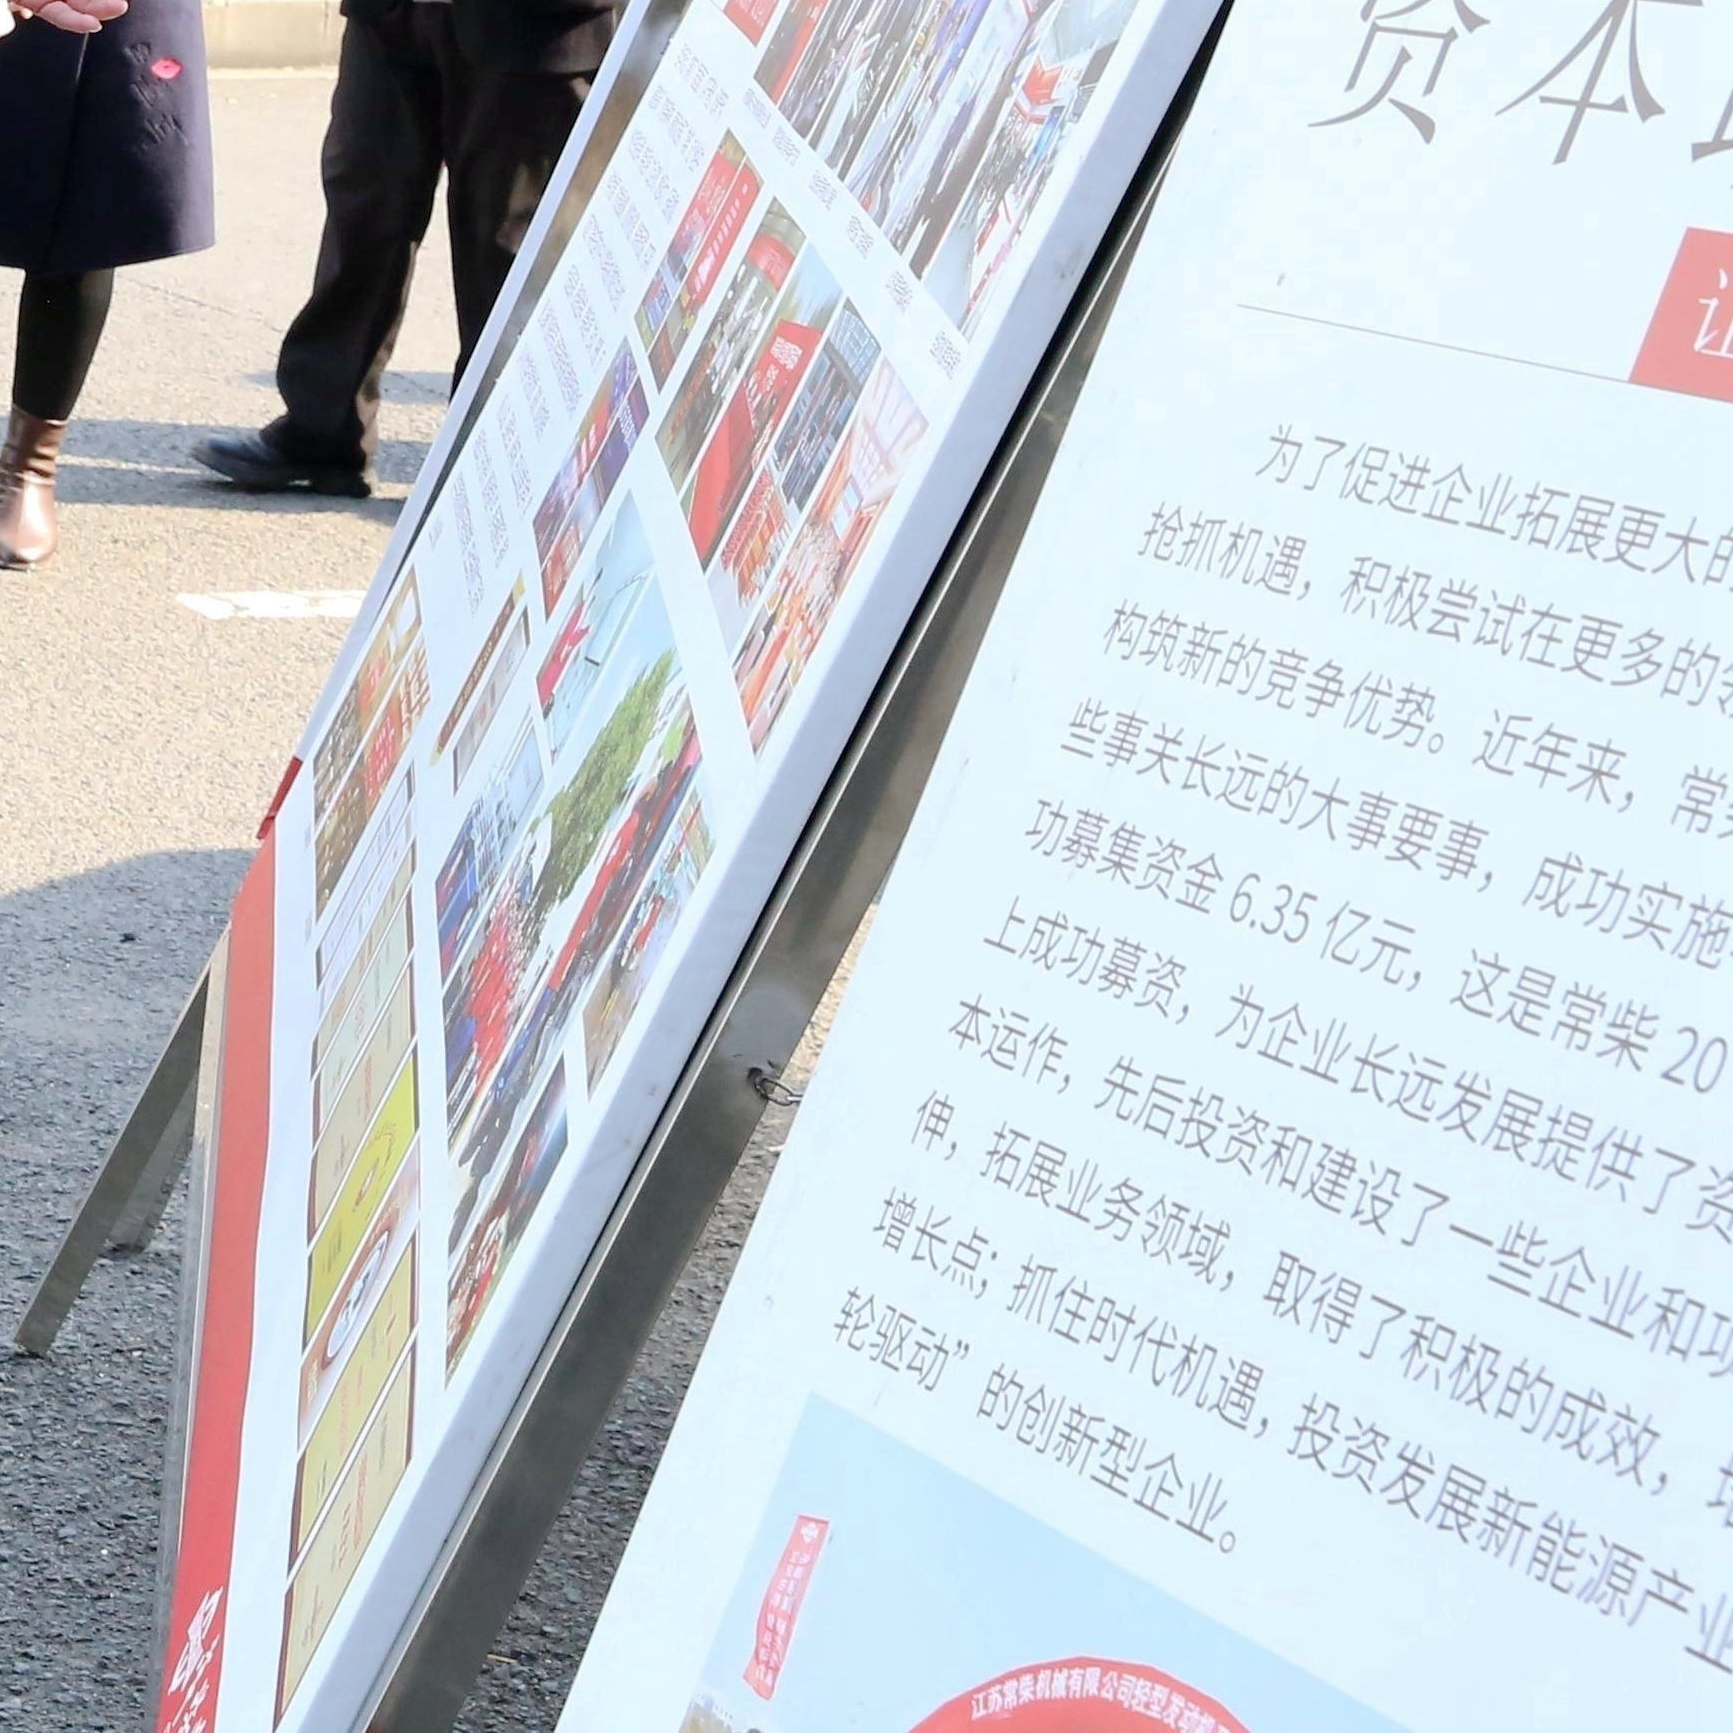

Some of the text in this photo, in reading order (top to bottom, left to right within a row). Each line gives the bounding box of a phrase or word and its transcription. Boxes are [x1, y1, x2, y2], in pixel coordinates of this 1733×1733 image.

[1137, 500, 1733, 719] 抢抓机遇，积极尝试在更多的
